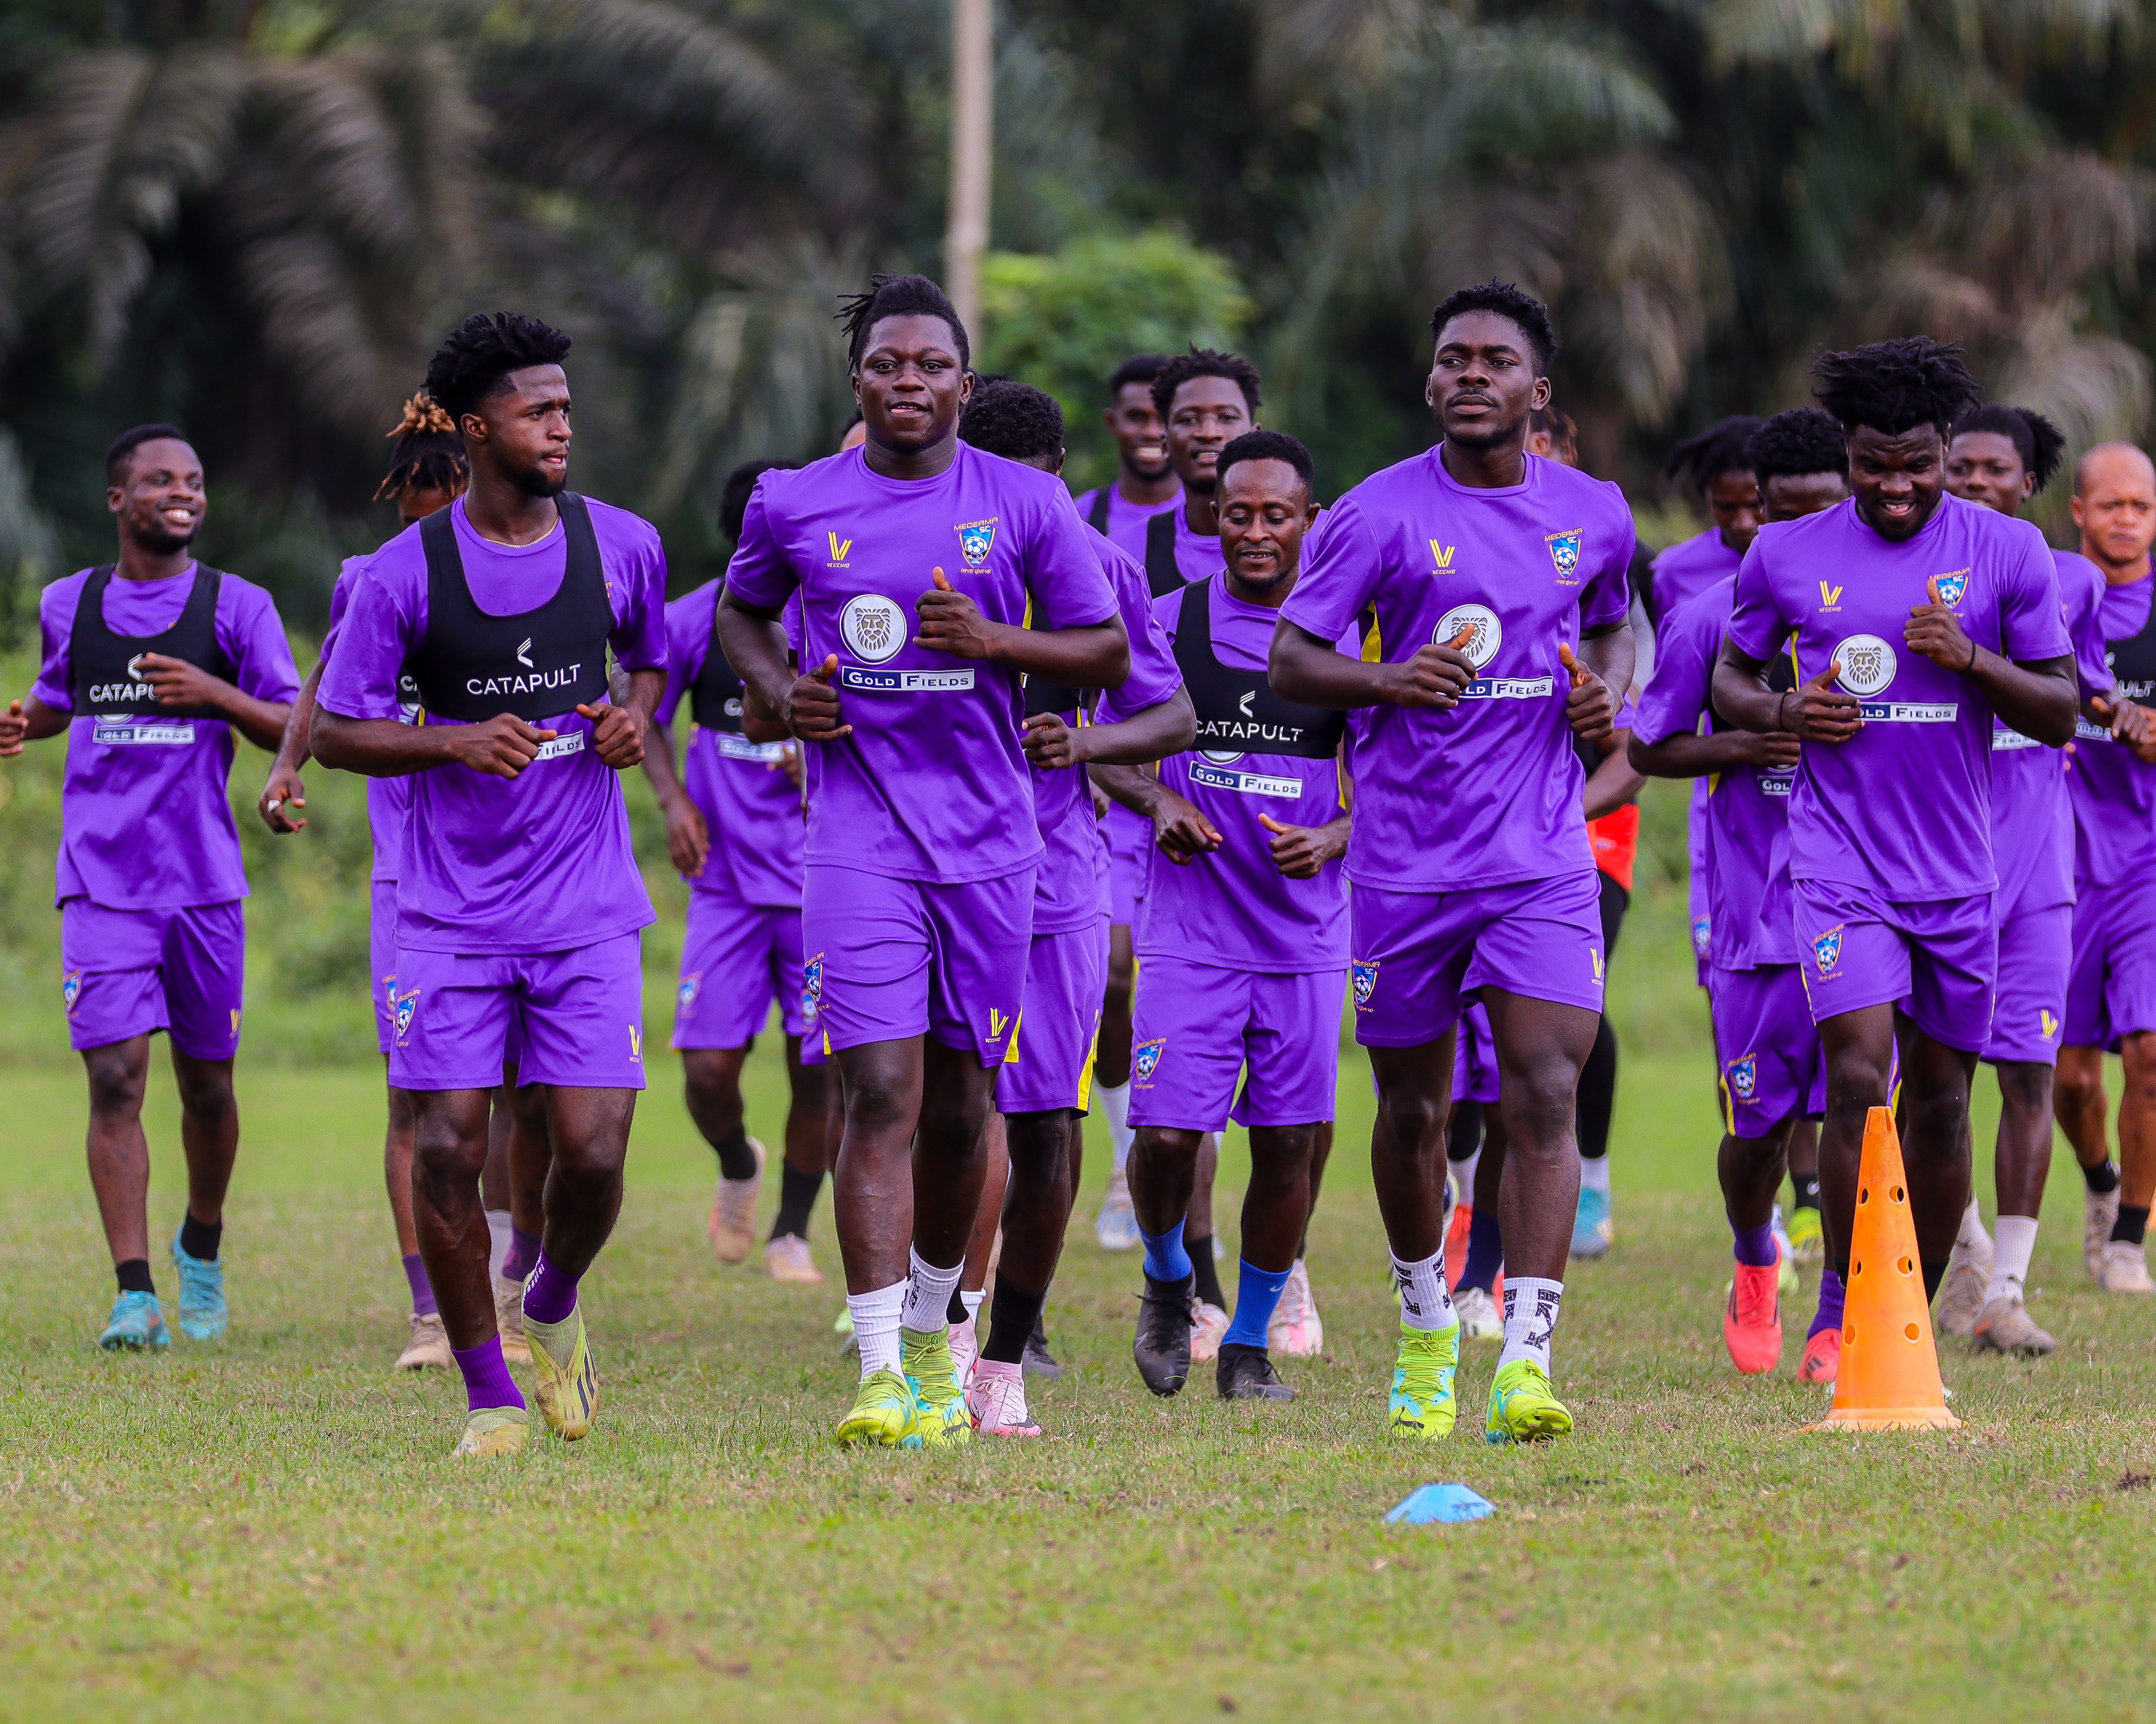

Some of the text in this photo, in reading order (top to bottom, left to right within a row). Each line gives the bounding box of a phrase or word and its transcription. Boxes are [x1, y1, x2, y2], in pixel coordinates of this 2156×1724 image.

[953, 516, 999, 531] MEDEAMA
[1544, 528, 1583, 542] MEDEAMA
[467, 663, 581, 695] CATAPULT
[849, 671, 969, 686] GOLD FIELDS
[89, 683, 161, 703] CATAPU
[1496, 683, 1547, 695] FIELDS
[1896, 707, 1951, 718] FIELDS
[1196, 720, 1304, 743] CATAPULT
[1195, 768, 1298, 794] GOLD FIELDS
[1762, 779, 1790, 791] GOL
